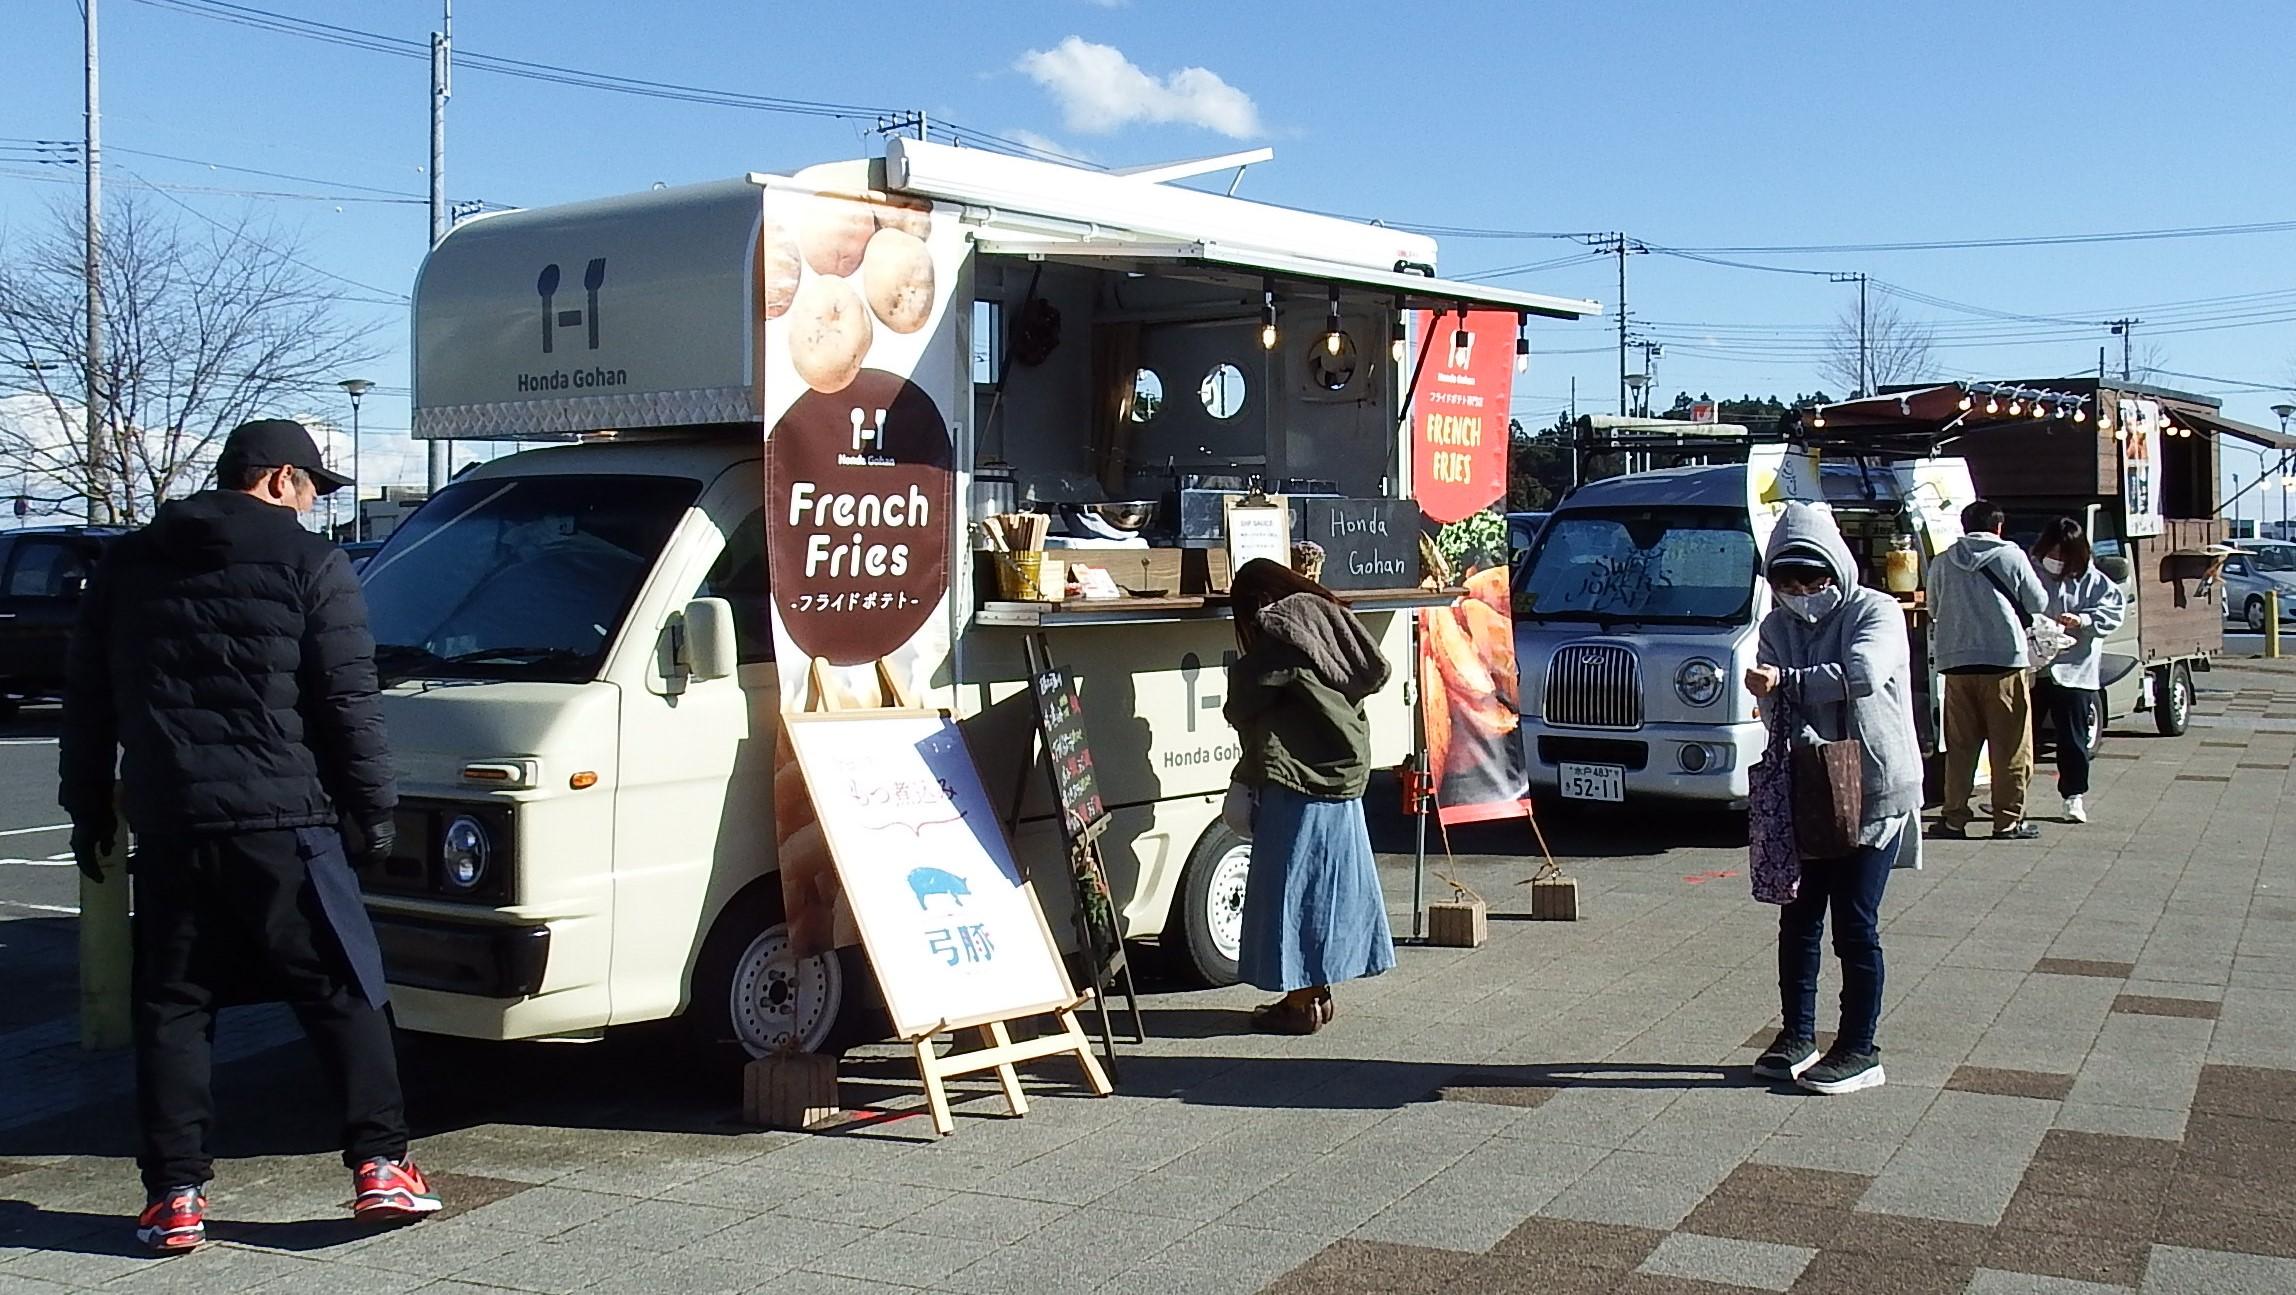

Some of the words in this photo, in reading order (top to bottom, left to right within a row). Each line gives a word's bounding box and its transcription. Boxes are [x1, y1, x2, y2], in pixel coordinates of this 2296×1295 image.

[518, 370, 569, 392] Honda
[573, 366, 627, 389] Gohan
[1426, 413, 1482, 447] FRENCH
[1433, 451, 1472, 485] FRIES
[789, 482, 929, 527] French
[1331, 507, 1388, 537] Honda
[805, 532, 909, 578] Fries
[1349, 548, 1405, 575] Gohan
[1164, 747, 1210, 768] Honda
[1214, 742, 1241, 762] Goh
[1573, 777, 1619, 799] 52-11
